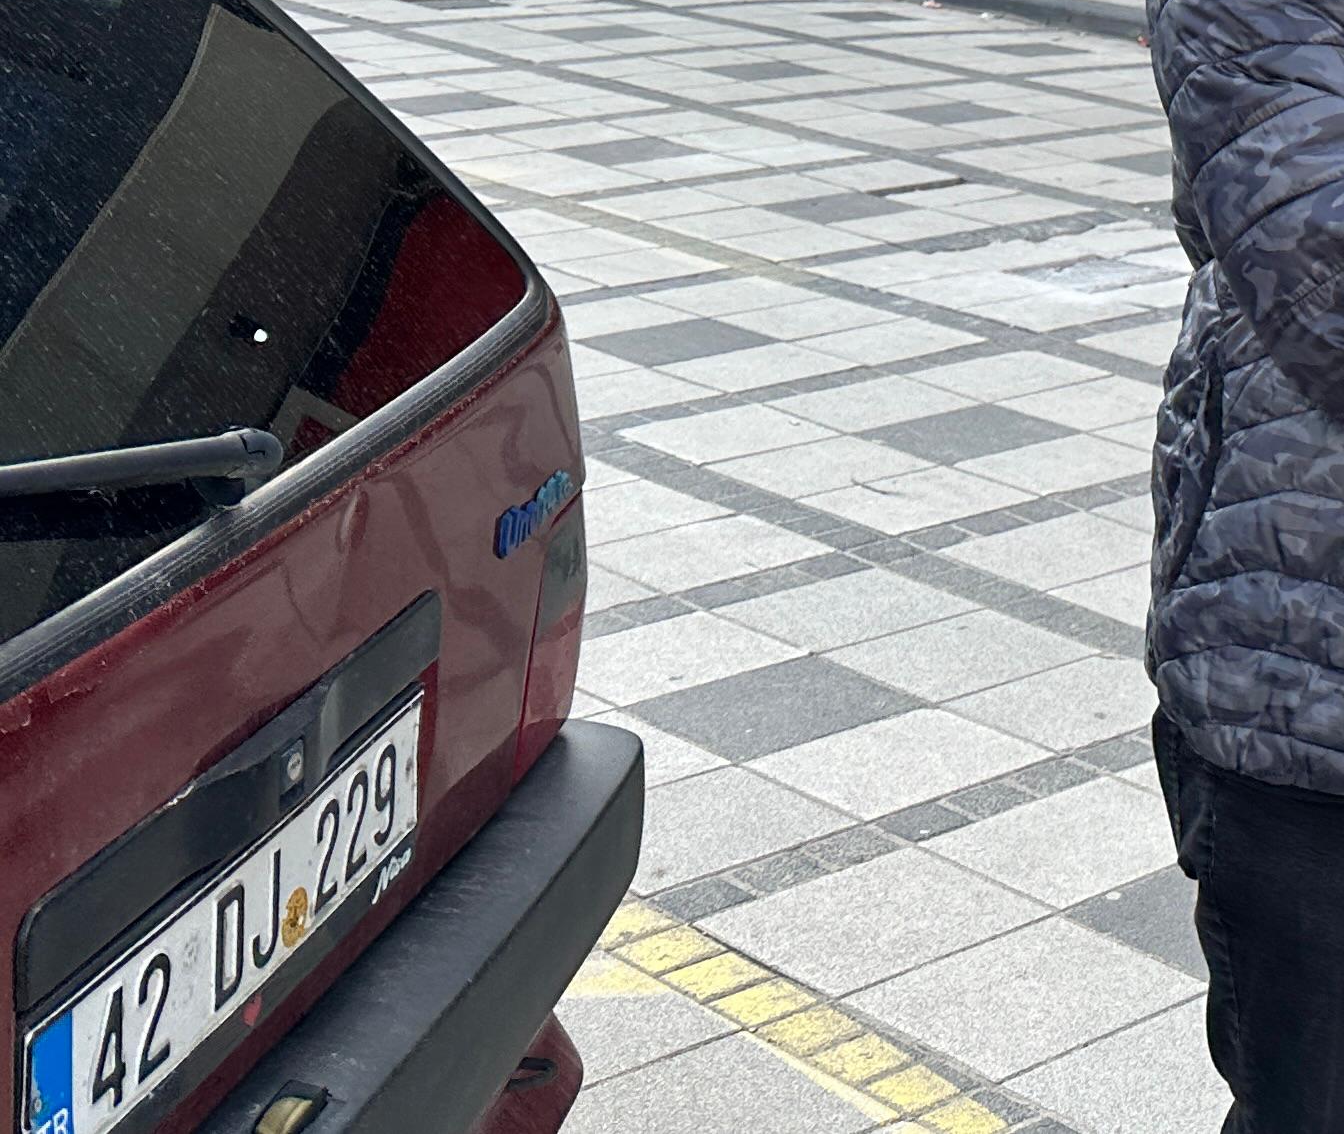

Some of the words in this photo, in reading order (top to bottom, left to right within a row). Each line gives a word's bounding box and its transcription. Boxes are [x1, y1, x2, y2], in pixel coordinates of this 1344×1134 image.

[91, 952, 172, 1108] 42
[213, 848, 282, 1014] DJ
[313, 742, 398, 919] 229
